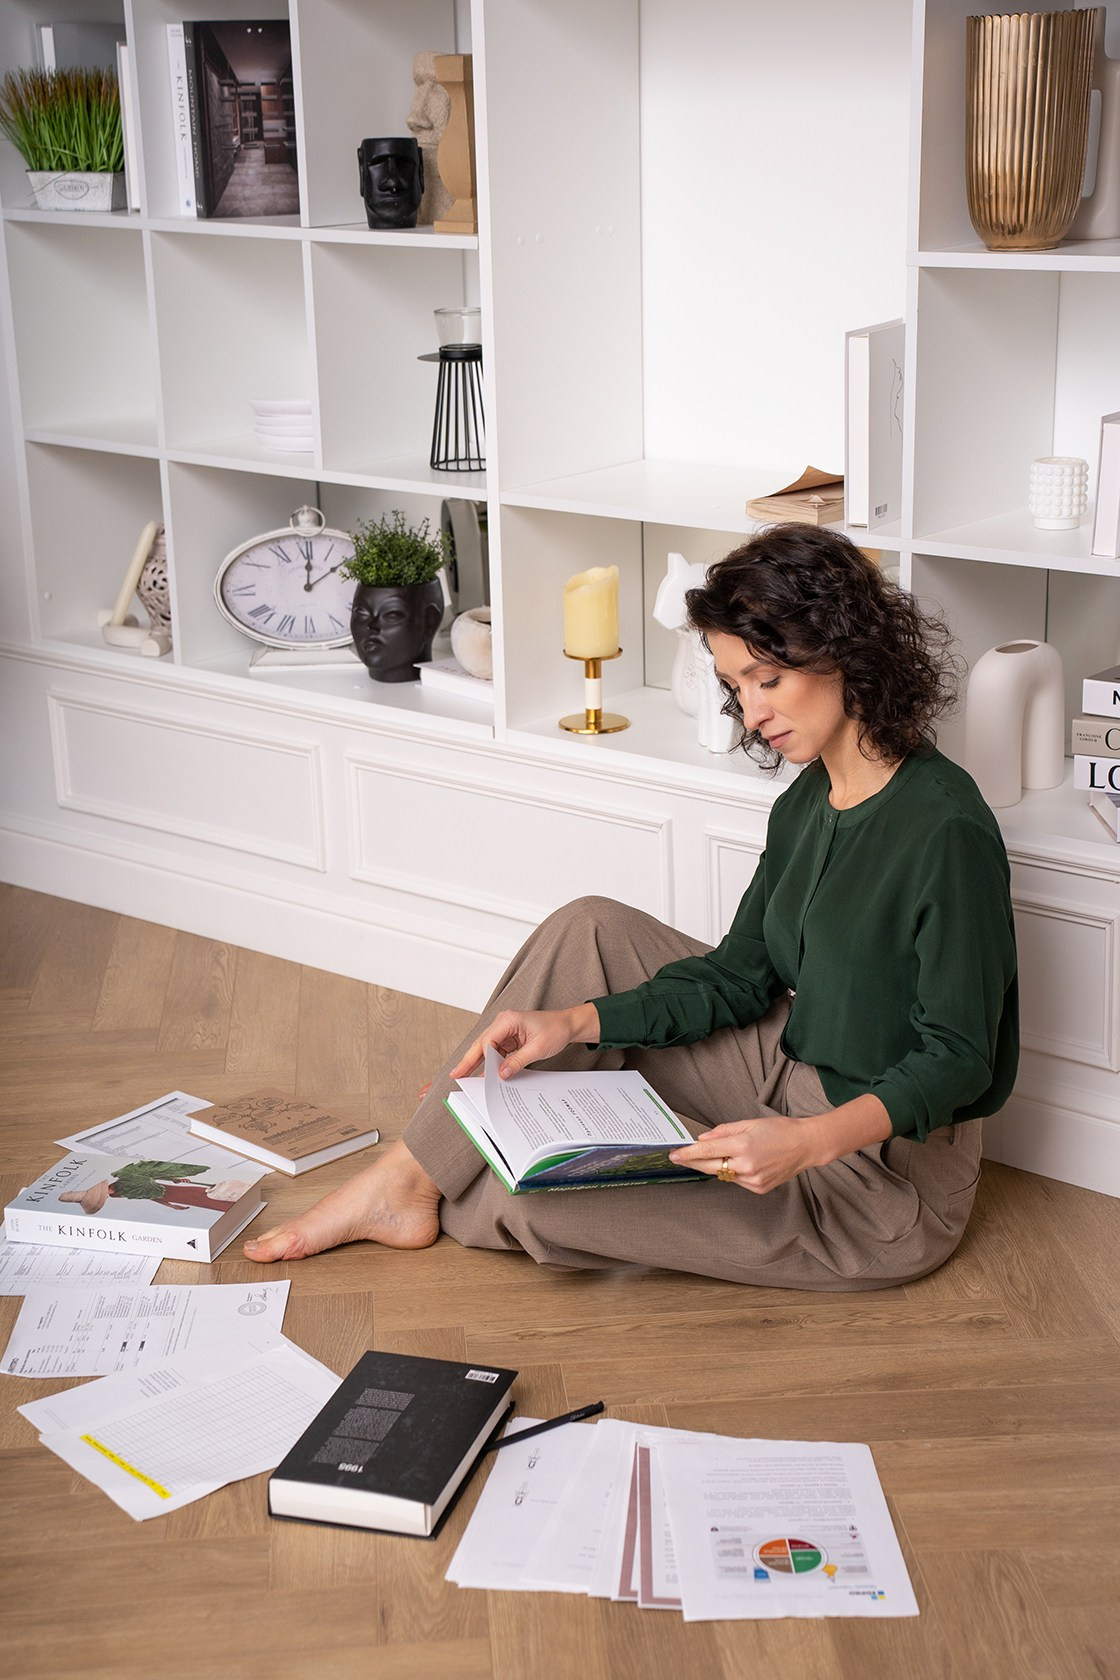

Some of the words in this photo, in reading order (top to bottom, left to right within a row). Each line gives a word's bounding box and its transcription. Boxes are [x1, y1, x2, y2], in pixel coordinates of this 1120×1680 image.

[176, 75, 187, 141] KINFOLK
[26, 1159, 88, 1202] KINFOLK
[548, 1184, 598, 1192] Марафон
[38, 1224, 53, 1232] THE
[58, 1224, 127, 1242] KINFOLK
[131, 1235, 163, 1244] GARDEN
